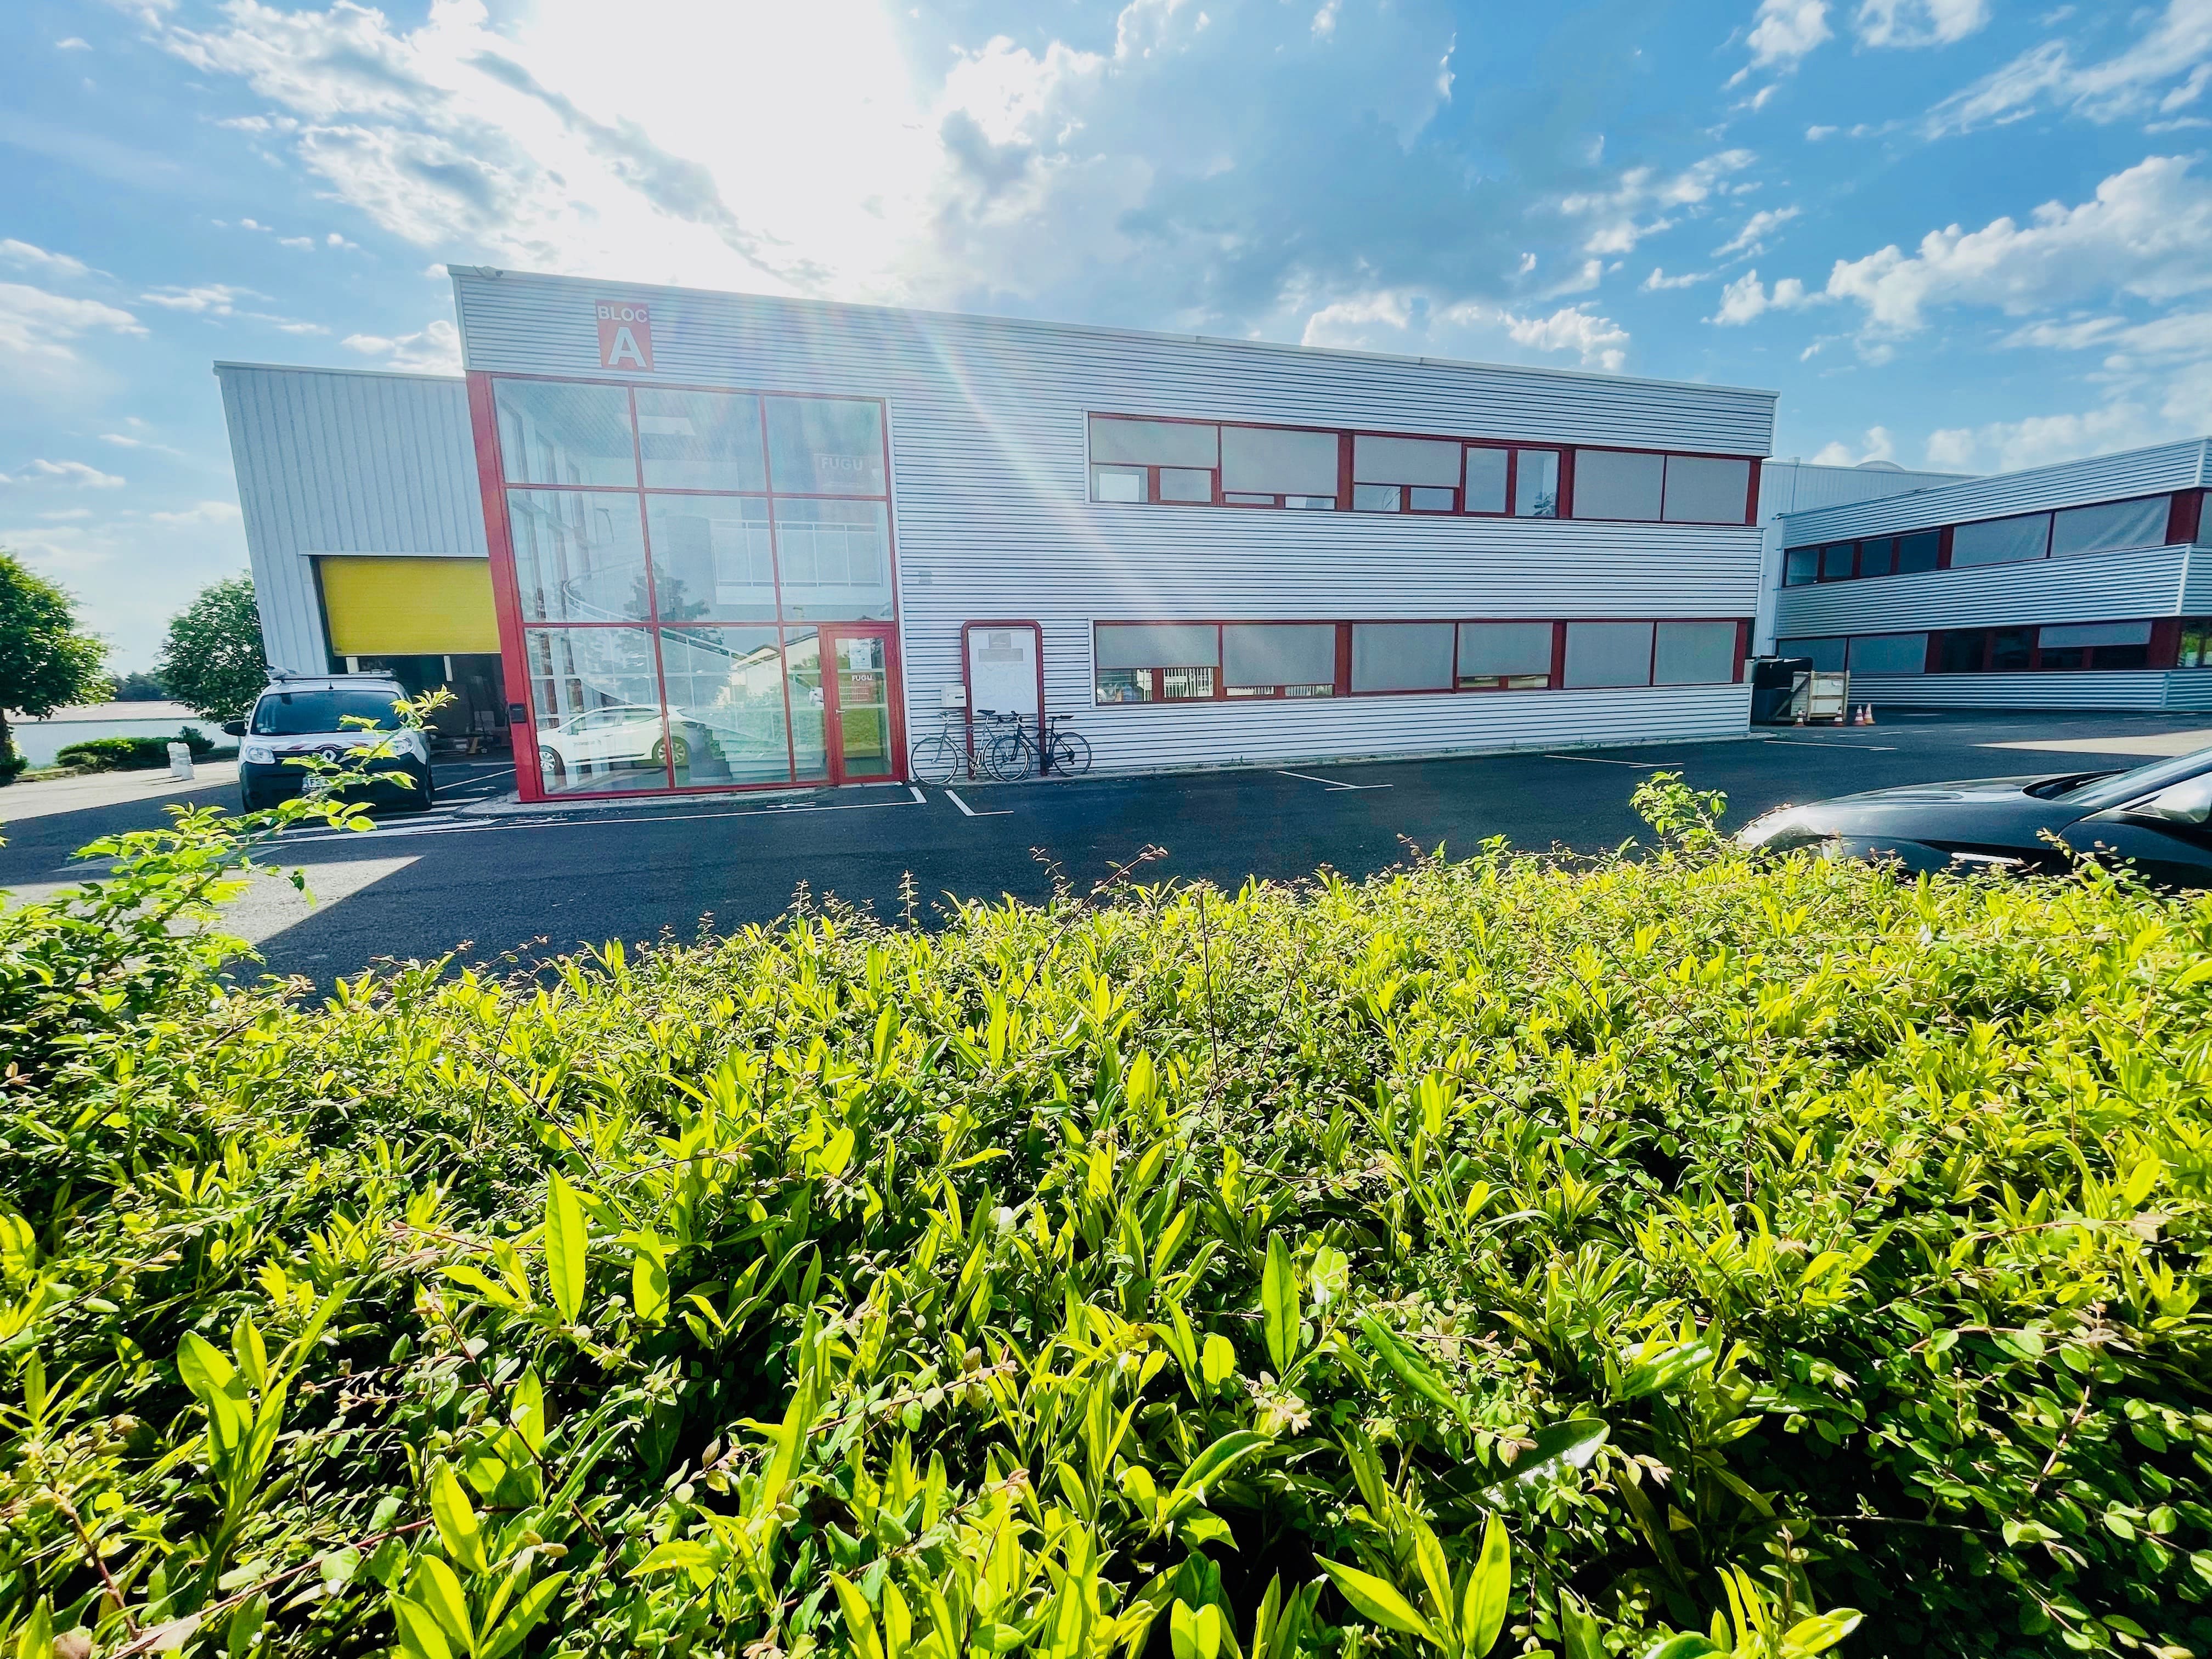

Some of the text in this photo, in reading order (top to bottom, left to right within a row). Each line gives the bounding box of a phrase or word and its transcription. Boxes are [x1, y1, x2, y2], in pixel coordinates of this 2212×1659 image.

[597, 305, 647, 323] BLOC
[608, 326, 647, 367] A
[821, 457, 863, 471] FUGU
